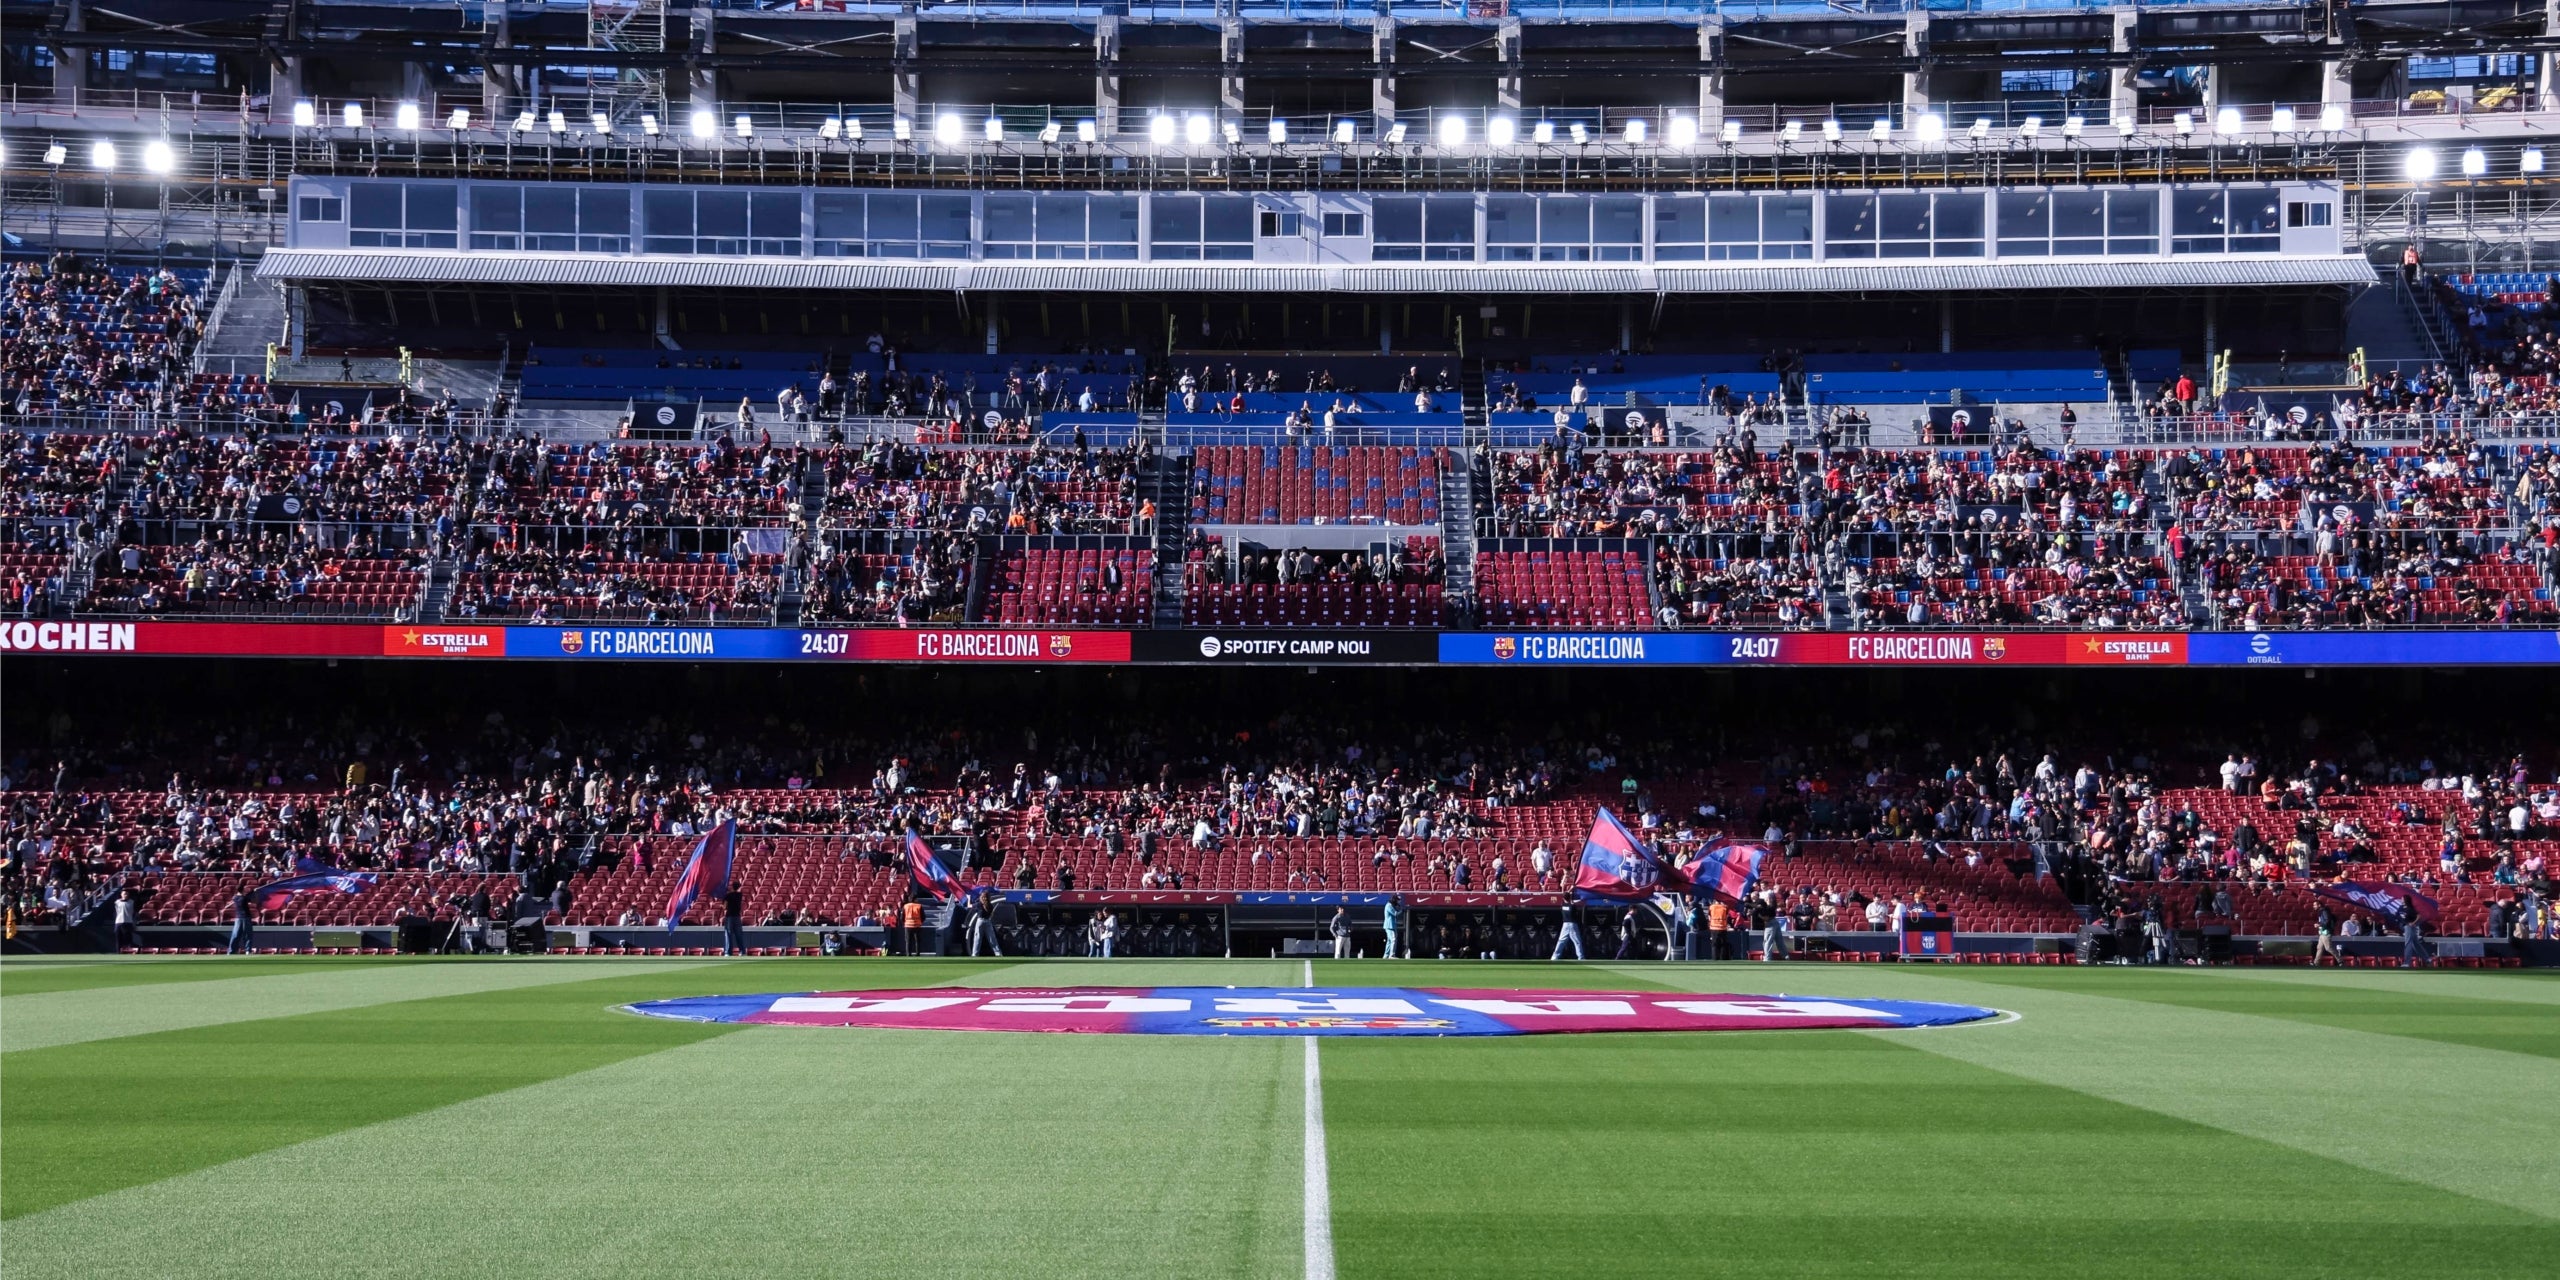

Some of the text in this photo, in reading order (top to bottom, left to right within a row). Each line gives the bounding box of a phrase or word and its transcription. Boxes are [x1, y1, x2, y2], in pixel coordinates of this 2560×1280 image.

[422, 633, 489, 646] ESTRELLA
[591, 632, 714, 654] FC BARCELONA
[801, 633, 849, 654] 24:07
[918, 634, 1039, 656] FC BARCELONA
[1223, 640, 1370, 655] SPOTIFY CAMP NOU
[1523, 637, 1645, 659] FC BARCELONA
[1731, 637, 1779, 658] 24:07
[1849, 637, 1973, 660] FC BARCELONA
[2104, 641, 2170, 653] ESTRELLA
[2125, 653, 2150, 661] DAMM
